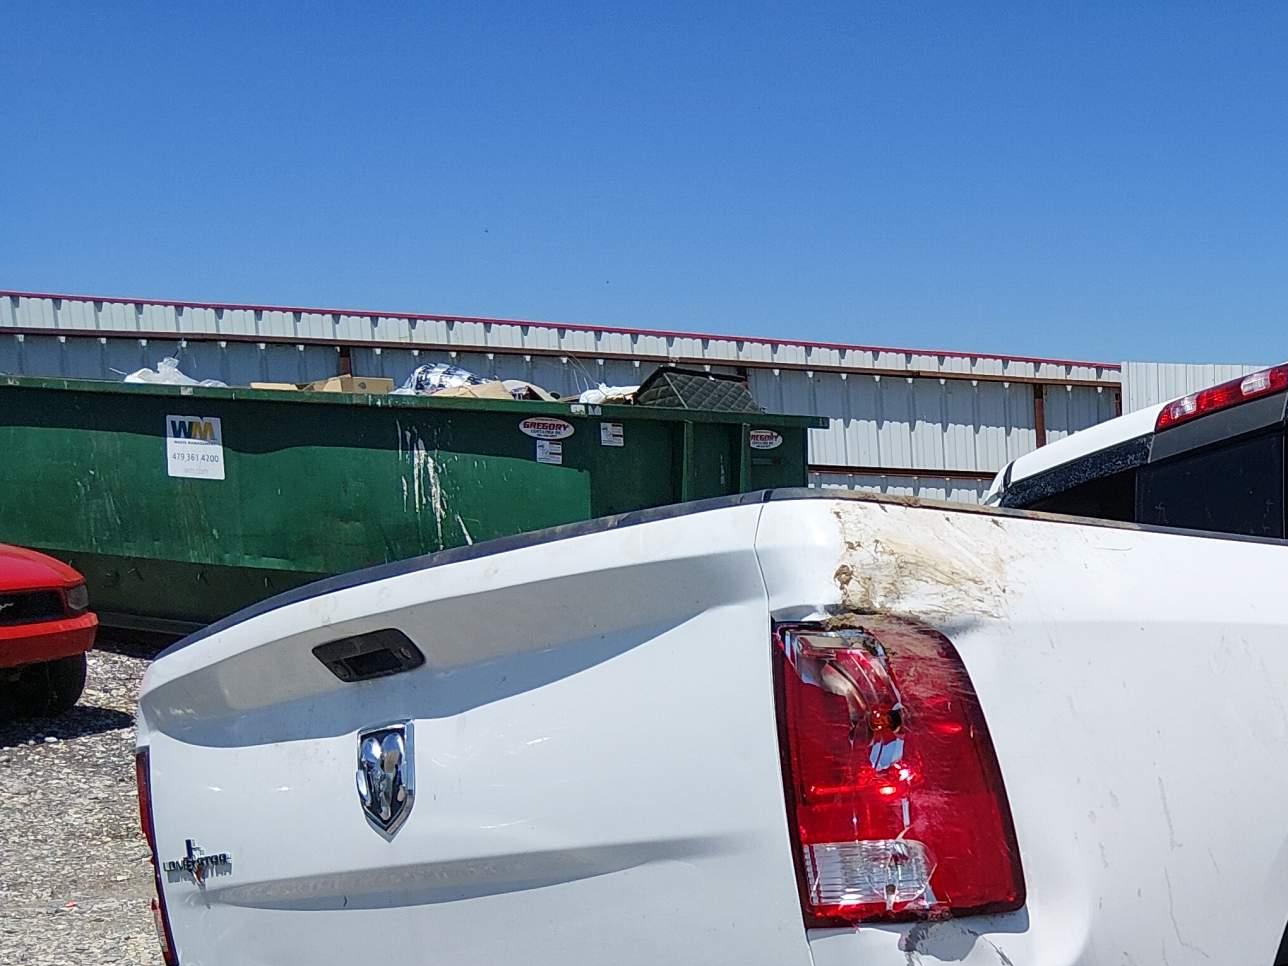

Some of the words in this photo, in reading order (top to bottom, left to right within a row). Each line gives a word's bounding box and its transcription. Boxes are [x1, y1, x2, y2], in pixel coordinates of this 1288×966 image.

[171, 420, 216, 440] WM
[523, 421, 569, 431] GREGORY
[751, 433, 778, 442] REGORY
